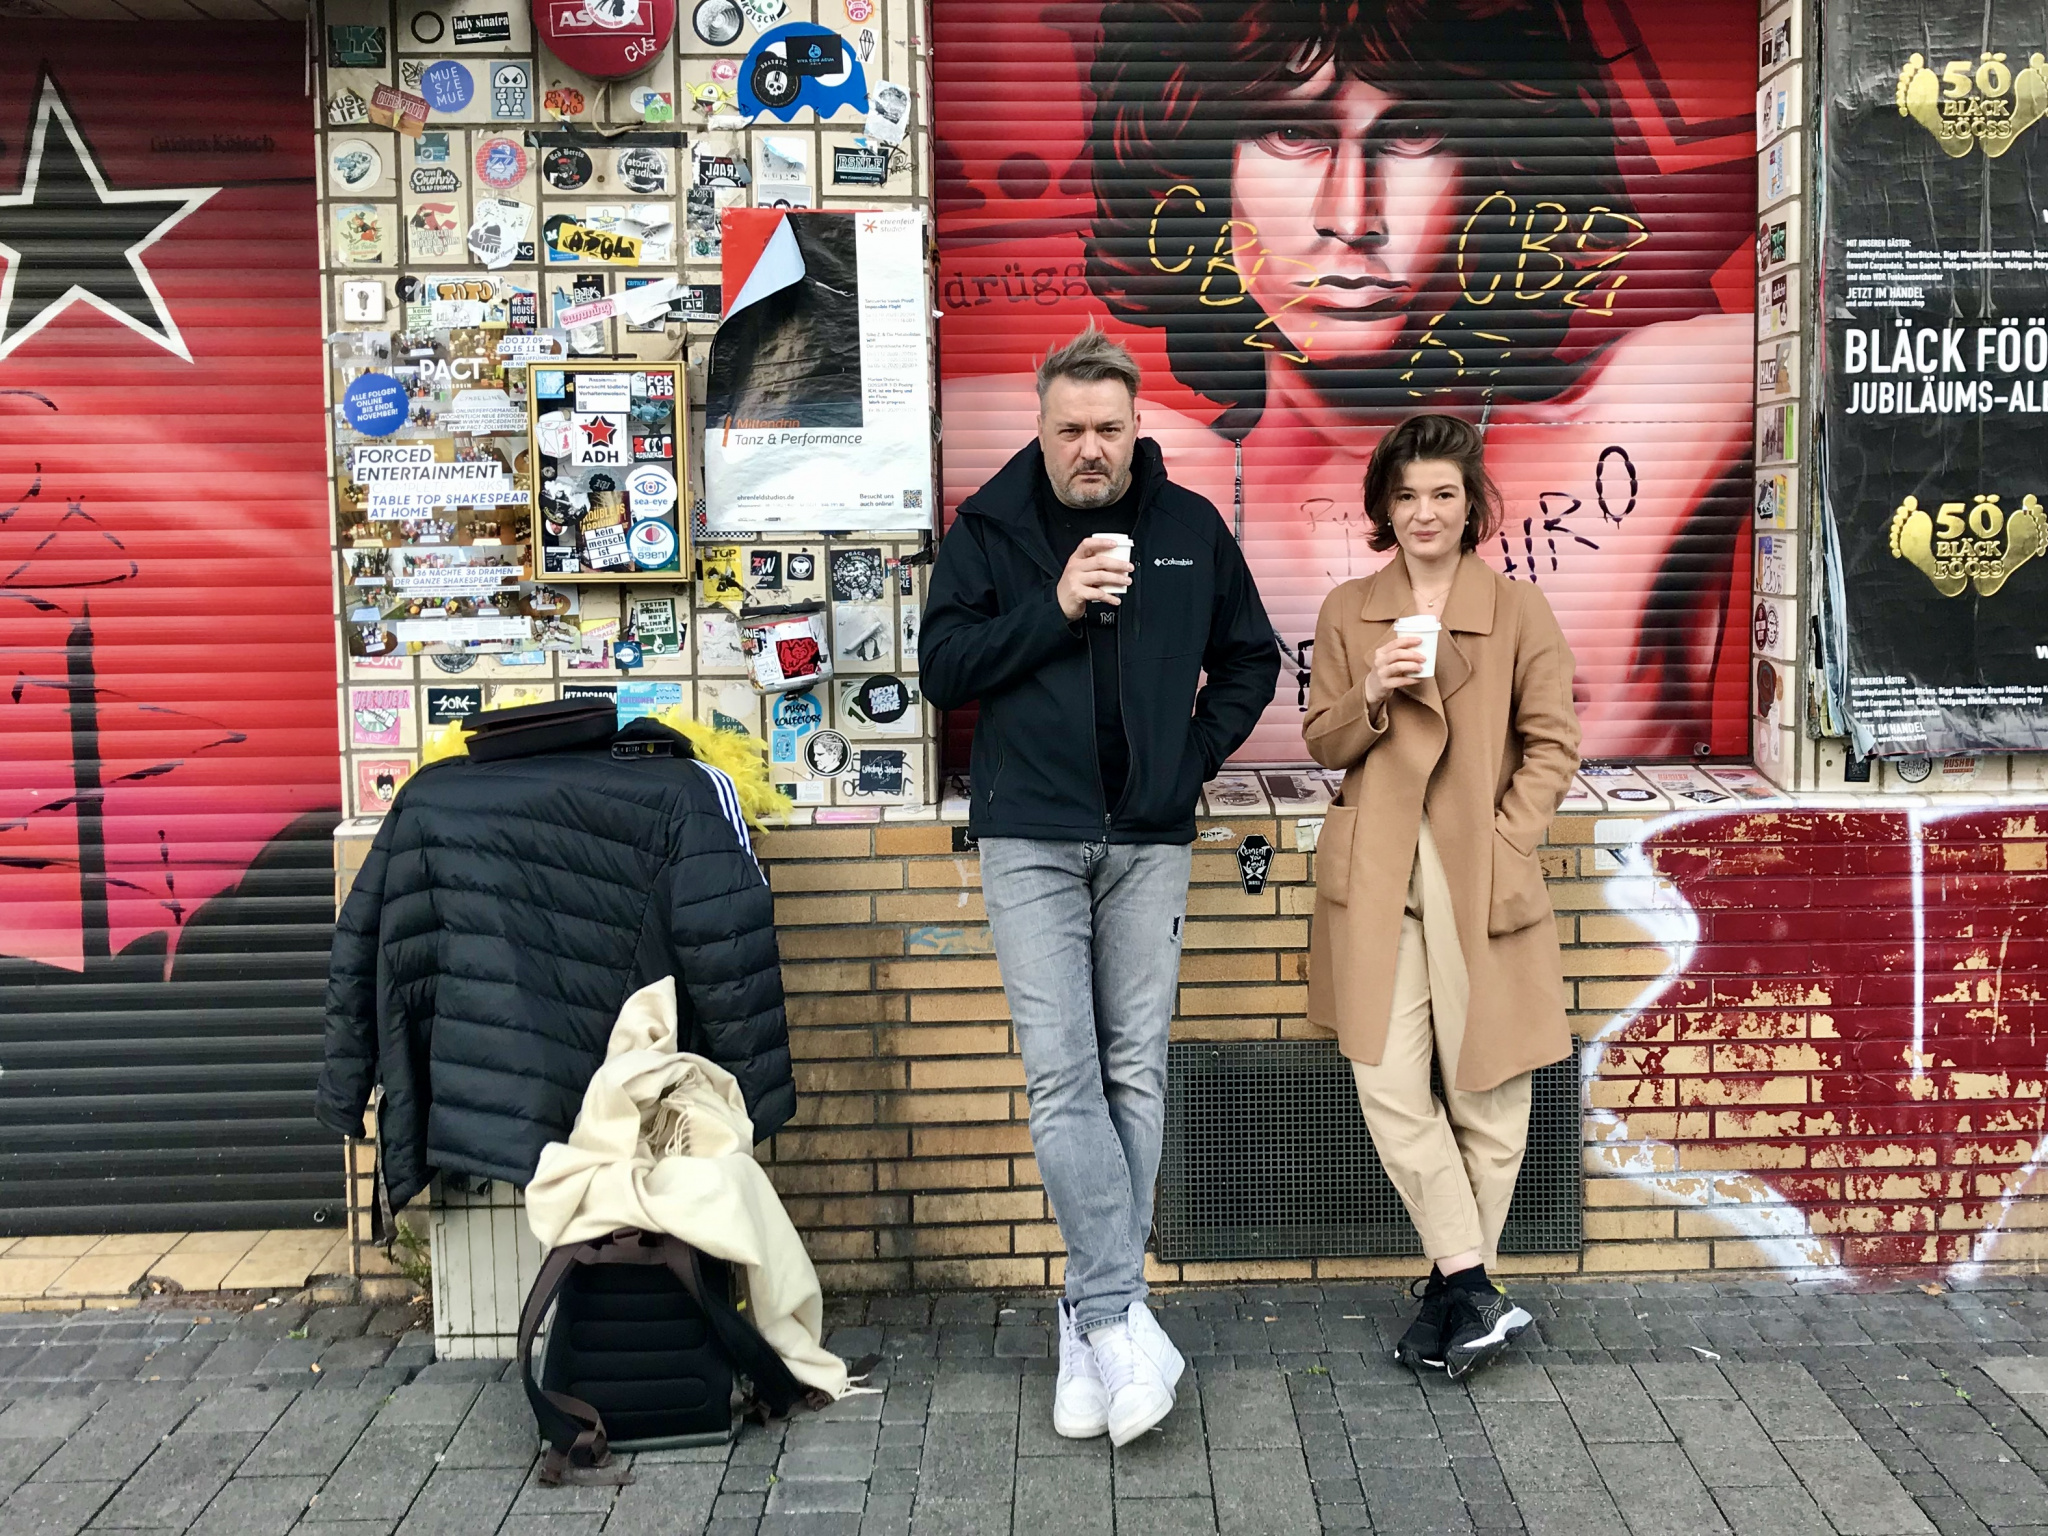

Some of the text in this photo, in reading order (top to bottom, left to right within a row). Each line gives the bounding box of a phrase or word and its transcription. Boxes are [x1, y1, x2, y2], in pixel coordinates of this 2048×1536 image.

[453, 15, 509, 31] lady sinatra
[430, 66, 459, 83] MUE
[436, 90, 465, 107] MUE
[626, 159, 660, 171] atomar
[629, 168, 654, 179] audio
[1846, 239, 1858, 247] MIT
[1859, 239, 1886, 247] UNSEREN
[1905, 261, 1918, 269] Tom
[1858, 273, 1872, 281] dem
[1872, 273, 1887, 281] WDR
[1846, 287, 1925, 299] JETZT IM HANDEL
[512, 306, 535, 315] HOUSE
[512, 315, 535, 324] PEOPLE
[1845, 318, 1965, 374] BLÄCK
[419, 358, 483, 381] PACT
[647, 375, 673, 386] FCK
[351, 387, 397, 402] ALLE FOLGEN
[647, 385, 674, 397] AFD
[356, 398, 383, 407] ONLINE
[361, 402, 394, 414] BIS ENDE
[357, 409, 398, 422] NOVEMBER!
[735, 433, 863, 447] Tanz & Performance
[358, 449, 432, 463] FORCED
[581, 450, 619, 463] ADH
[356, 465, 498, 481] ENTERTAINMENT
[372, 496, 410, 506] TABLE
[417, 495, 441, 505] TOP
[370, 507, 428, 518] AT HOME
[595, 527, 614, 538] kein
[588, 535, 625, 548] mensch
[1936, 538, 2002, 557] BLÄCK
[598, 547, 610, 556] ist
[602, 554, 622, 567] egal
[1161, 558, 1193, 567] Columbia
[478, 568, 514, 576] DRAMEN
[443, 576, 500, 585] SHAKESPEARE
[869, 684, 899, 699] NEON
[871, 693, 900, 706] MEGA
[871, 701, 900, 715] DRIVE
[775, 714, 821, 726] COLLECTORS
[1878, 722, 1925, 735] IM HANDEL
